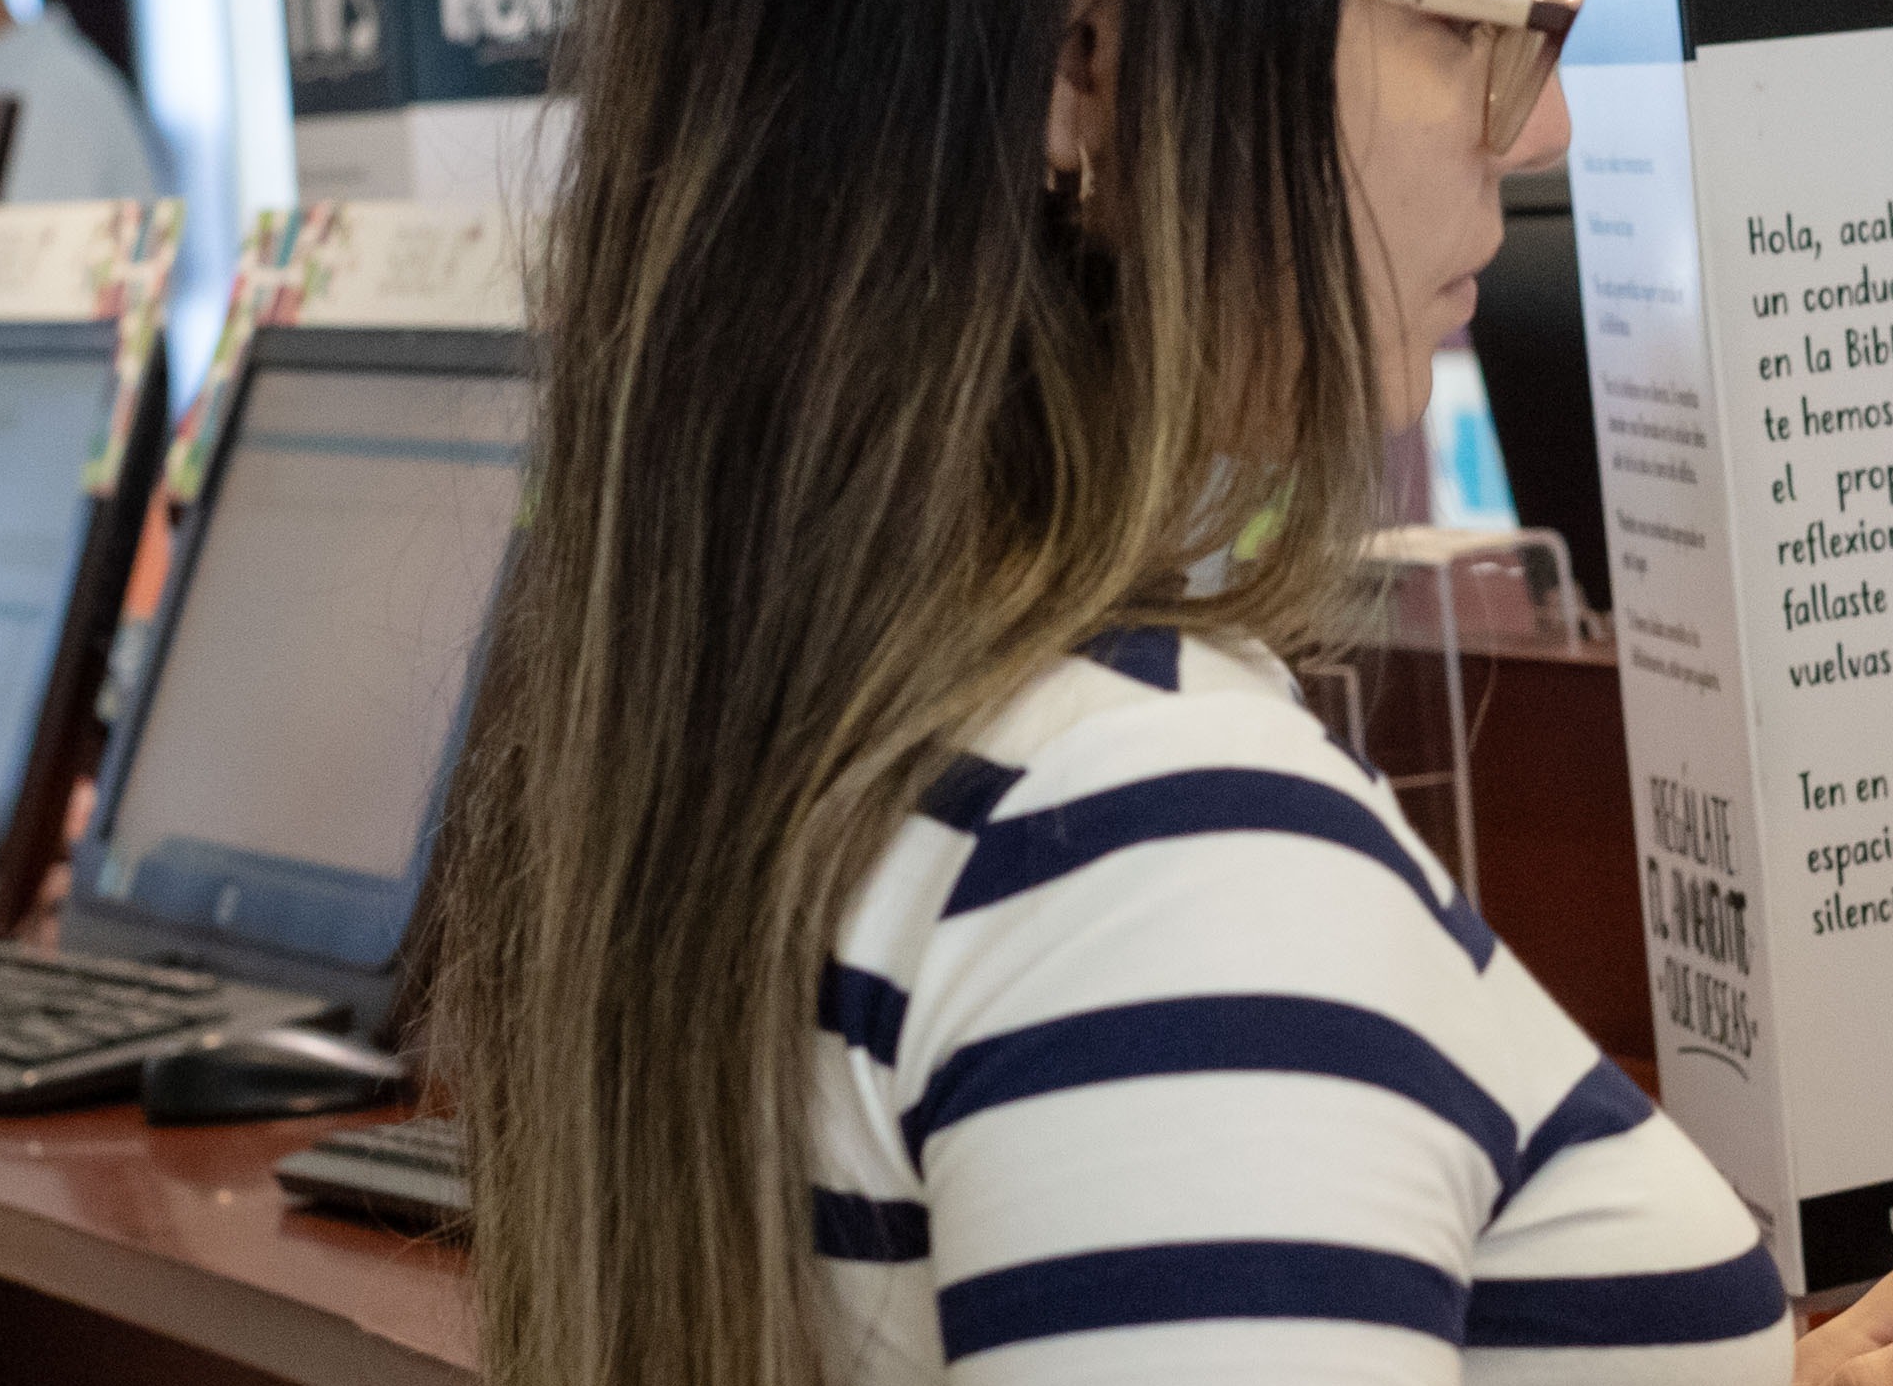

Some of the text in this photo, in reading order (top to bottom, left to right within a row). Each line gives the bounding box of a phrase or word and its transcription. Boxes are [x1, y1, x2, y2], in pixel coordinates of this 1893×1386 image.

[1747, 212, 1822, 258] Hola,
[1752, 292, 1788, 319] un
[1758, 354, 1791, 381] en
[1805, 335, 1831, 373] la
[1764, 407, 1790, 442] te
[1801, 389, 1893, 437] hemos
[1771, 462, 1796, 504] el
[1783, 581, 1886, 631] fallaste
[1789, 638, 1892, 688] vuelvas
[1798, 771, 1845, 810] Ten
[1856, 775, 1888, 802] en
